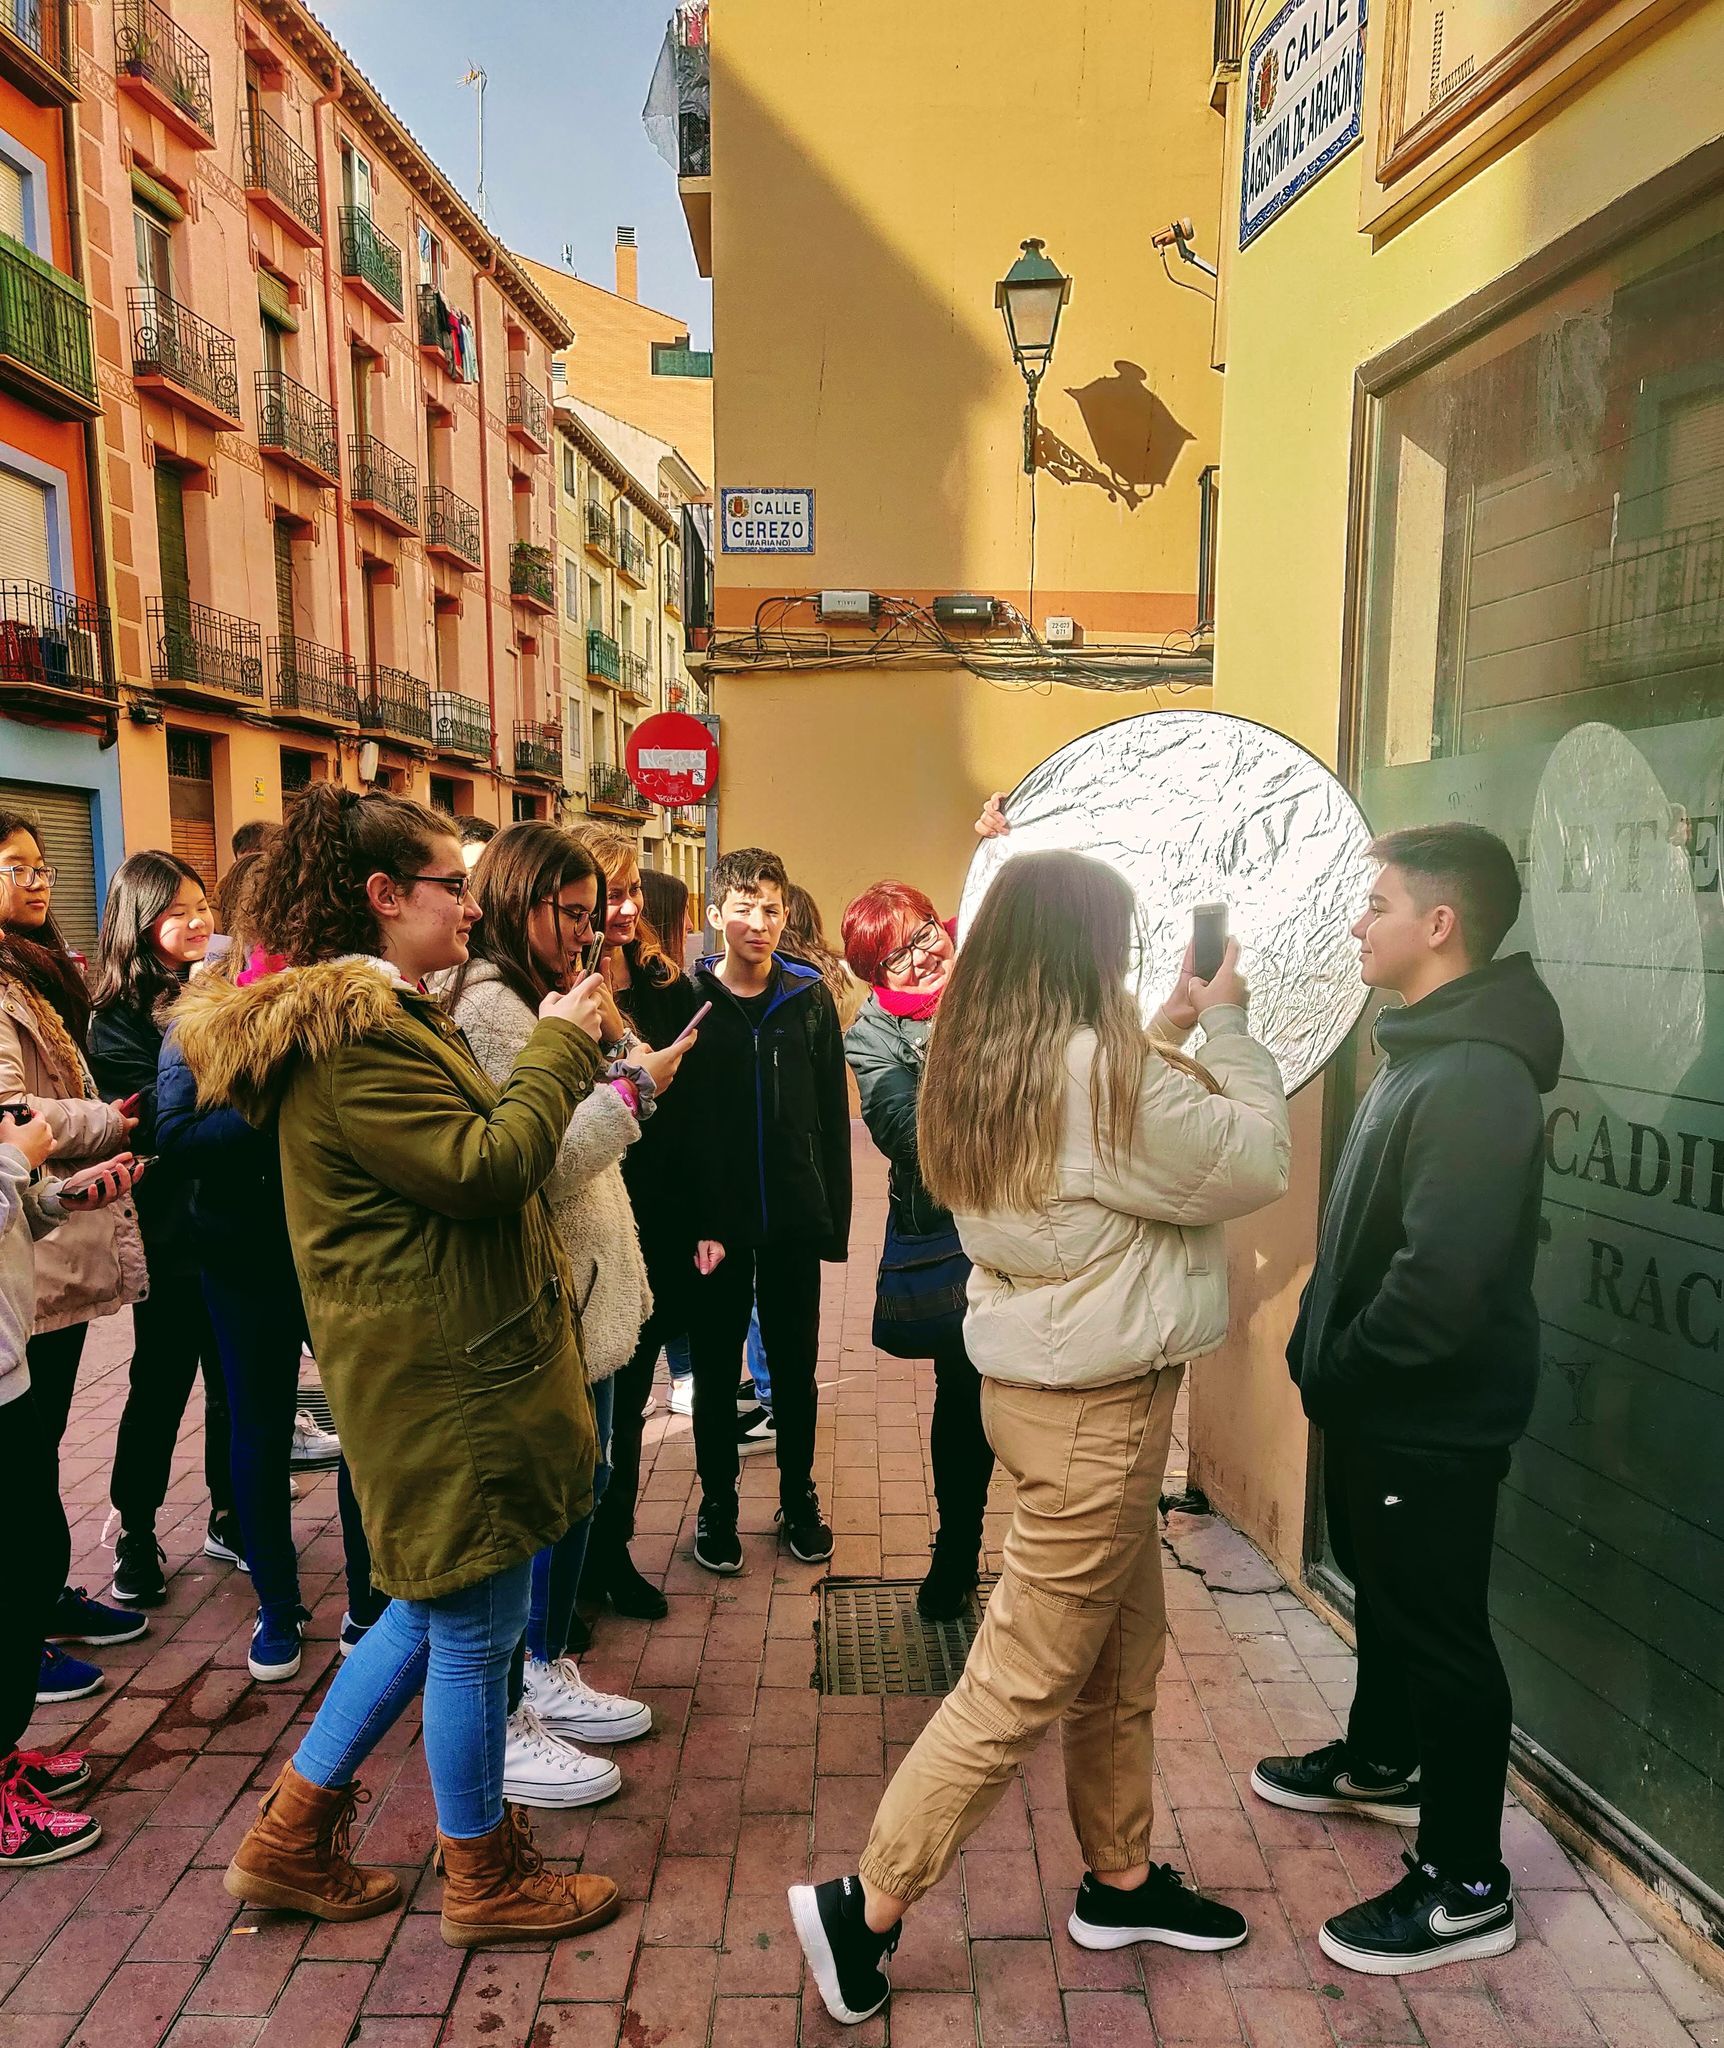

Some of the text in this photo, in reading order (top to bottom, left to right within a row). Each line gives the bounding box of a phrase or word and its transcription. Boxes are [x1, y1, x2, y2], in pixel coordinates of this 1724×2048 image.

[1284, 0, 1348, 82] CALLE
[1248, 45, 1355, 206] AGUSTINA DE ARAGÓN
[732, 521, 804, 538] CEREZO
[754, 501, 801, 515] CALLE
[745, 539, 791, 547] (MARIANO)
[1583, 1238, 1722, 1353] RAC
